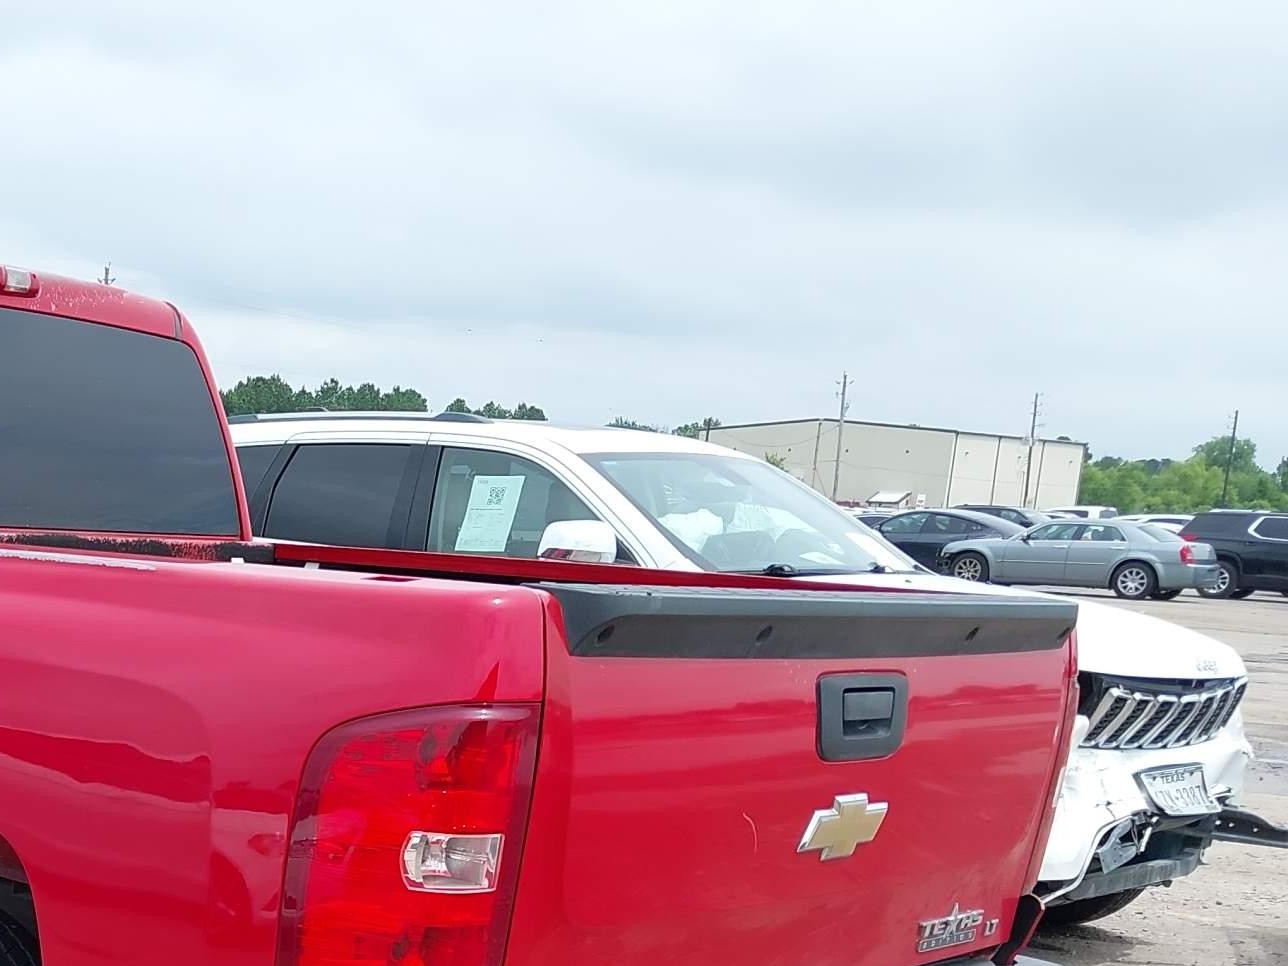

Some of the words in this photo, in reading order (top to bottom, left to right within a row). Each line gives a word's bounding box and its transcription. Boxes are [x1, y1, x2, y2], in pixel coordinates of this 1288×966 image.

[1160, 773, 1185, 784] TEXAS
[919, 903, 984, 937] TEXAS
[983, 918, 998, 936] LT
